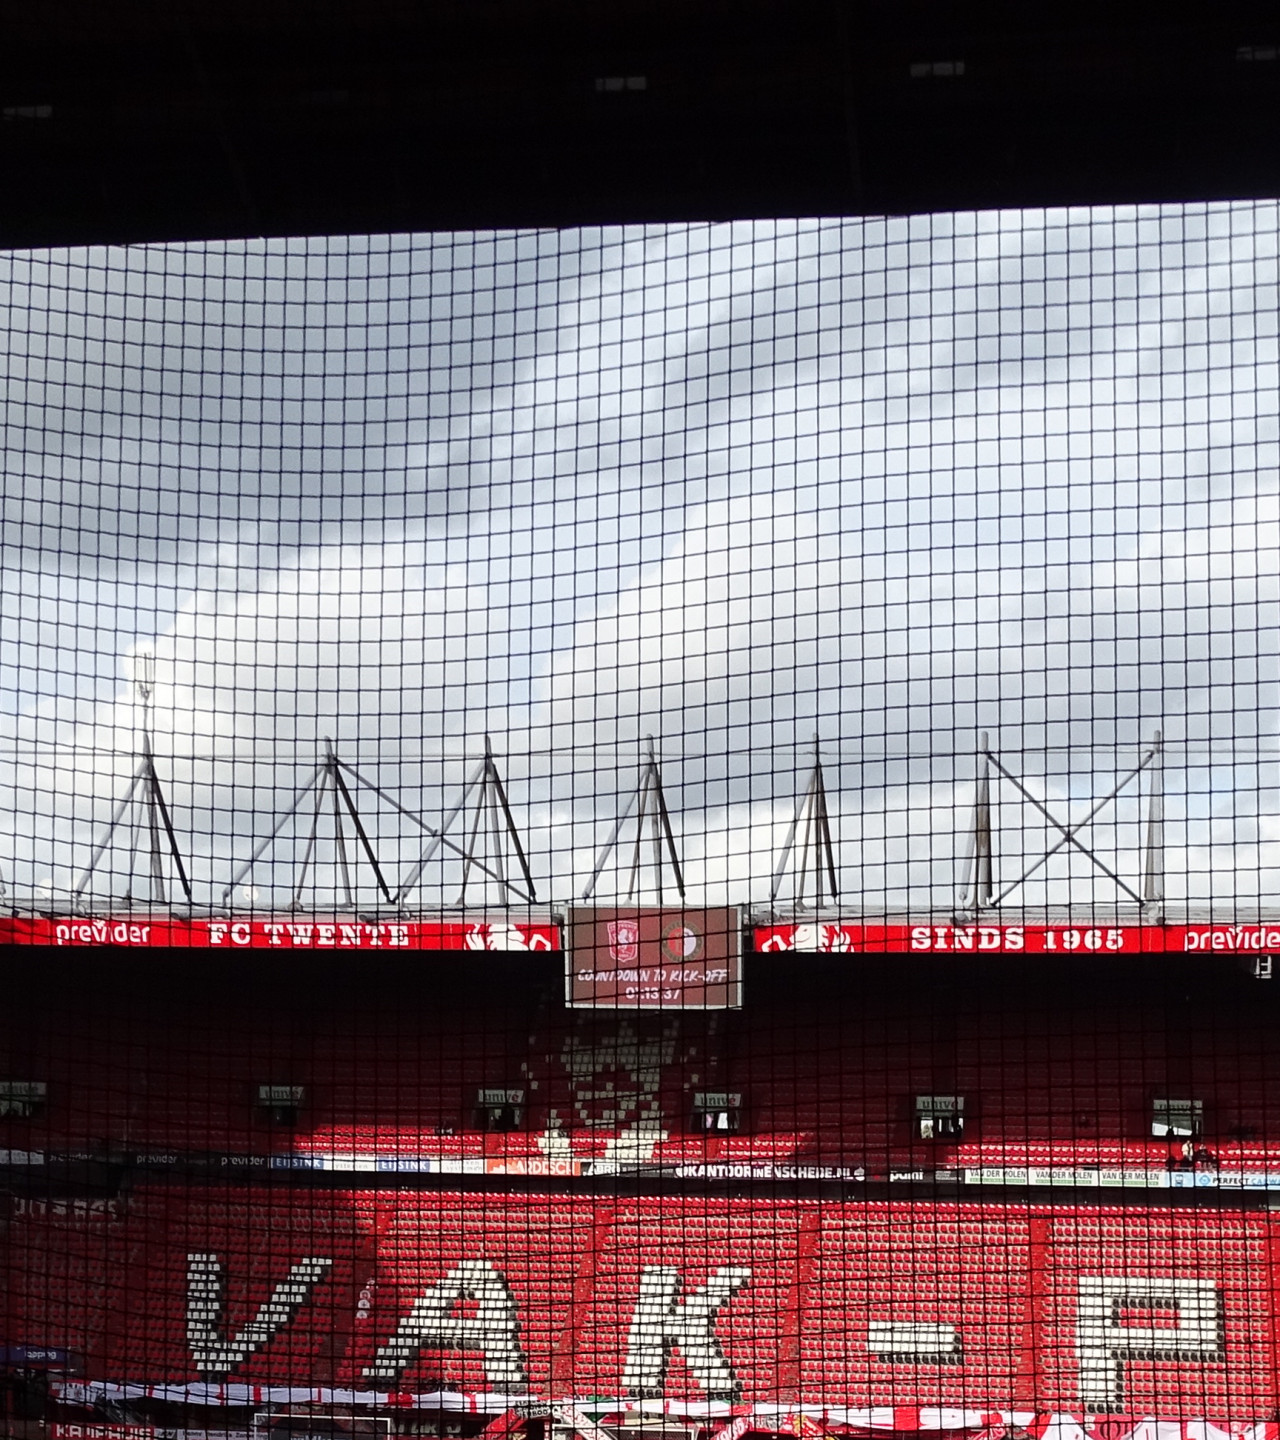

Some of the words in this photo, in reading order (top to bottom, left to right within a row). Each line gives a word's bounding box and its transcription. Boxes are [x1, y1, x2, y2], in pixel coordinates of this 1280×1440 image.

[56, 921, 150, 945] previder
[207, 923, 251, 944] FC
[269, 924, 410, 946] TWENTE
[911, 926, 1025, 950] SINDS
[1043, 928, 1124, 950] 1965
[577, 969, 650, 982] COUNTDOWN
[654, 969, 667, 981] TO
[670, 968, 729, 982] KICK-OFF
[625, 987, 681, 1000] 01:1337
[517, 1161, 570, 1176] ARDESCH
[971, 1170, 984, 1178] VAN
[986, 1170, 1001, 1178] DER
[1036, 1171, 1050, 1179] VAN
[1102, 1172, 1117, 1180] VAN
[1212, 1177, 1250, 1185] PERFECT
[56, 1424, 152, 1440] KAMPHUIS
